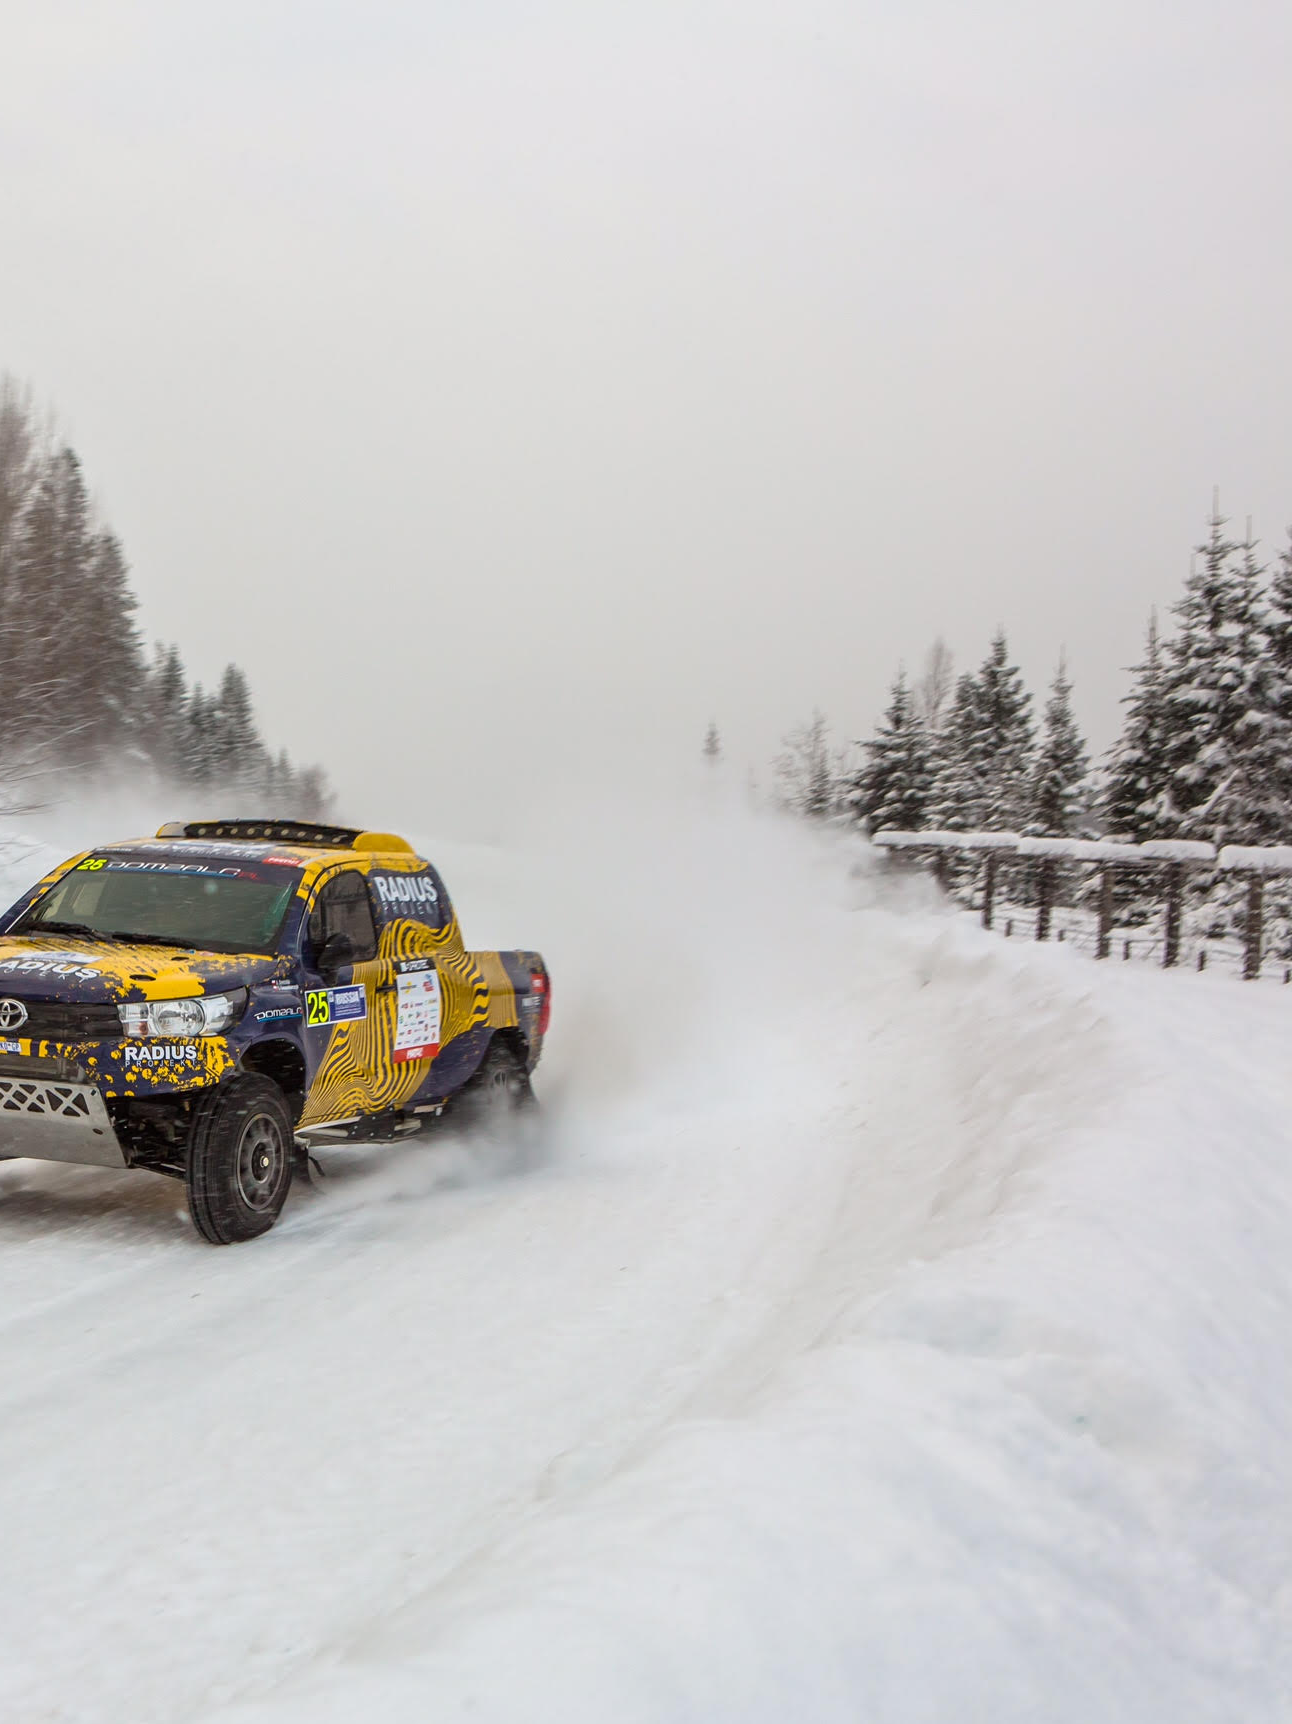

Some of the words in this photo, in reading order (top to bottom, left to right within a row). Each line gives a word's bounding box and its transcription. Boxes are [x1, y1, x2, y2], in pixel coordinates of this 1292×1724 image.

[77, 859, 107, 872] 25
[374, 876, 437, 901] RADIUS
[307, 991, 329, 1024] 25
[125, 1045, 197, 1061] RADIUS
[125, 1059, 196, 1067] PROJEKT
